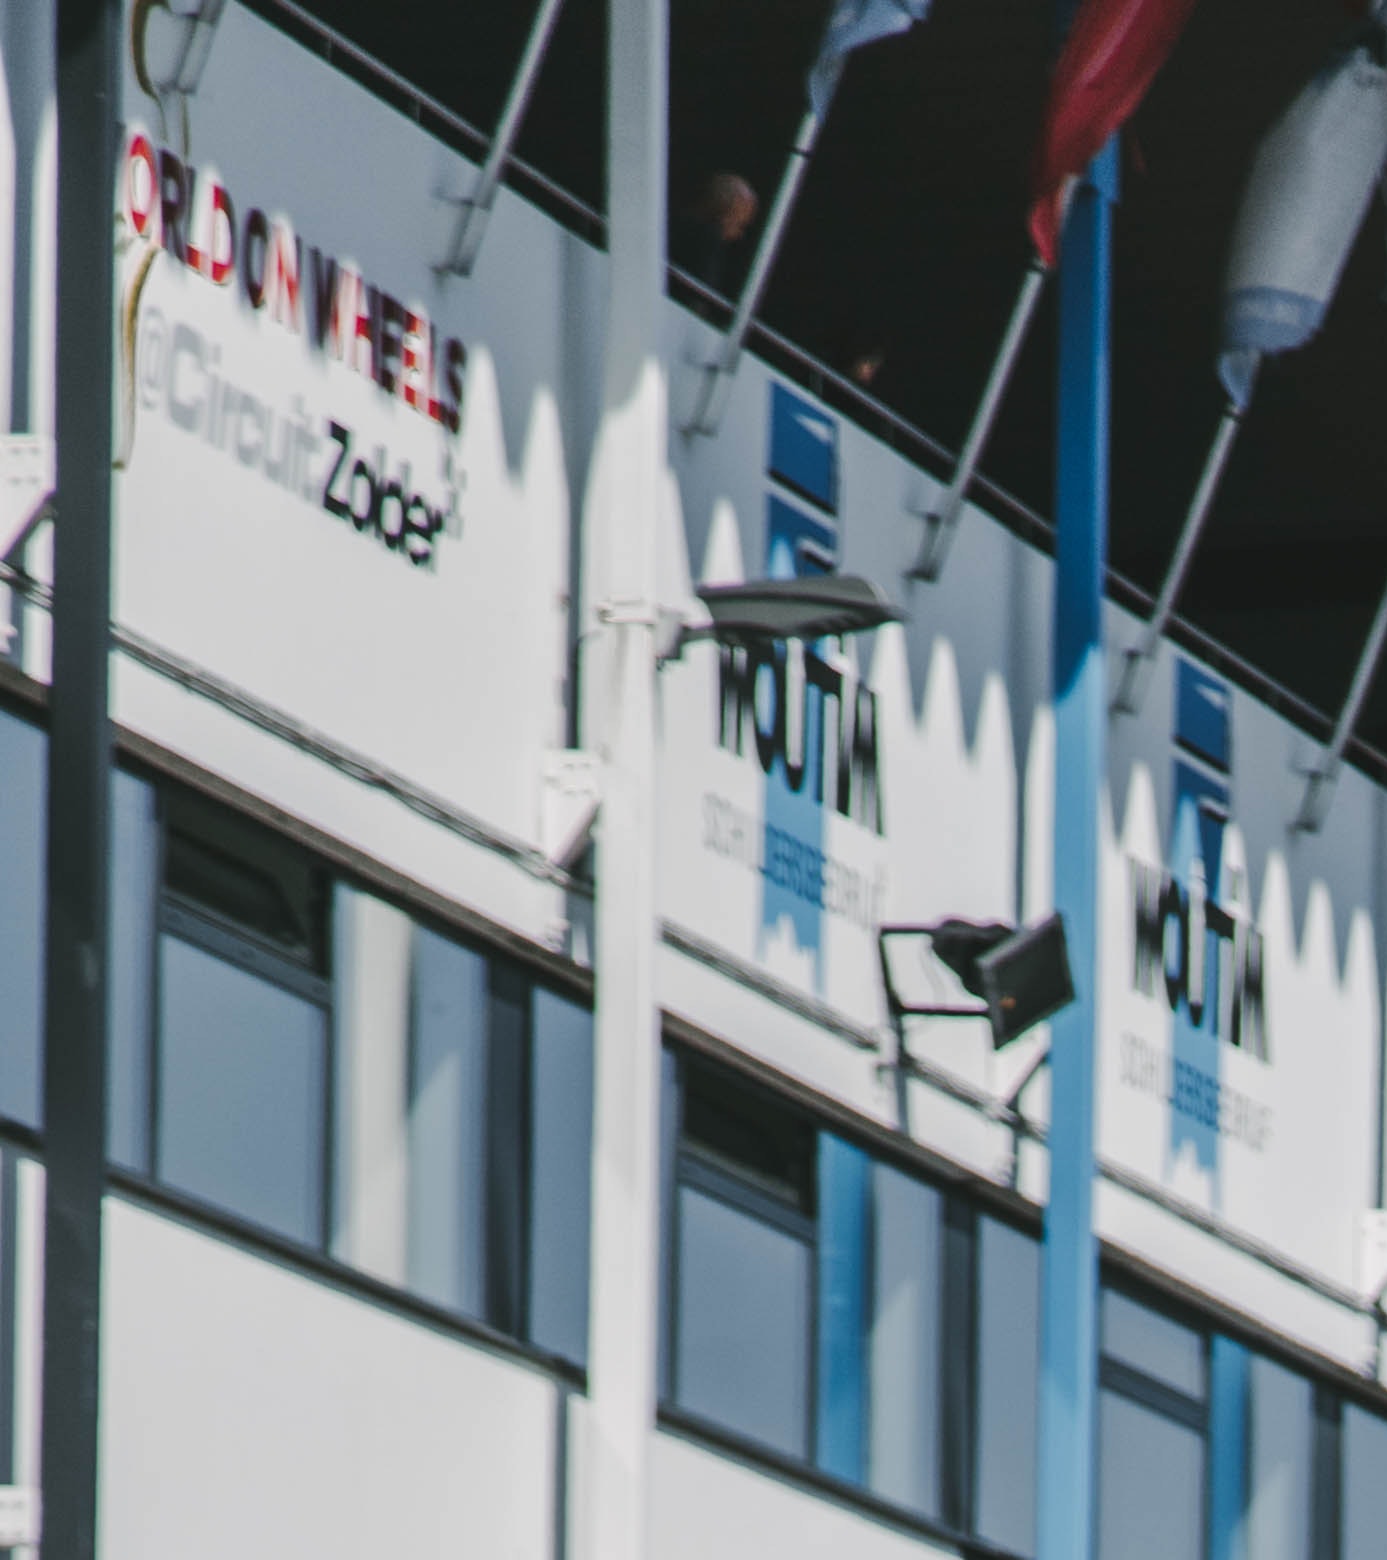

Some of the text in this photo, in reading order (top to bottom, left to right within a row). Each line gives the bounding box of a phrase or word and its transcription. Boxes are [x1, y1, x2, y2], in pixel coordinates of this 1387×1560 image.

[125, 133, 469, 435] ORLD ON WHEELS
